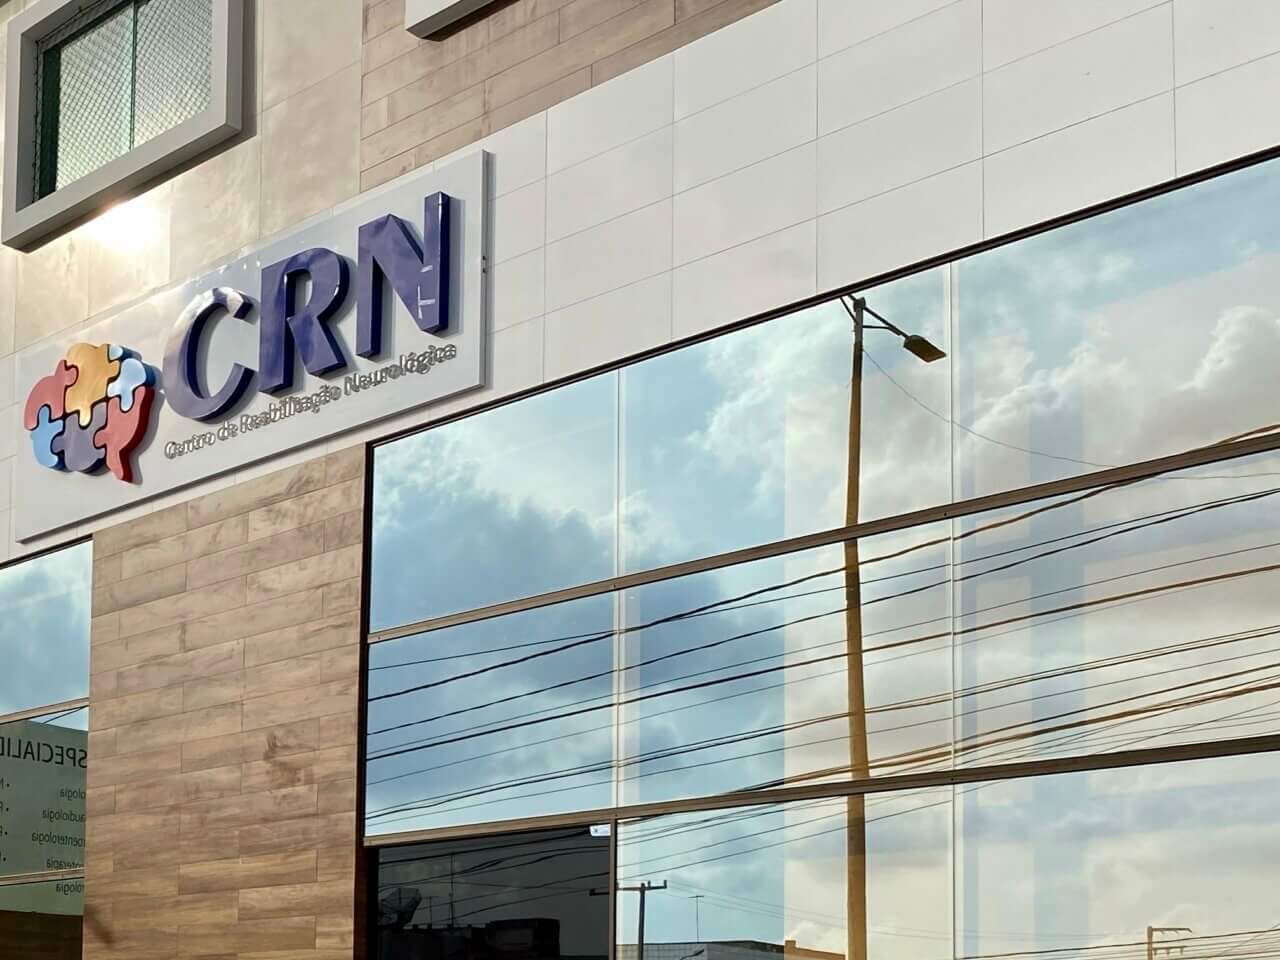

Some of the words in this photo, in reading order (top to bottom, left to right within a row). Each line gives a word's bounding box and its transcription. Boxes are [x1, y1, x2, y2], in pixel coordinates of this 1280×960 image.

[162, 190, 451, 423] CRN
[164, 431, 216, 460] Centro
[218, 421, 239, 441] de
[240, 384, 342, 434] Reabilitação
[344, 343, 457, 396] Neurológica
